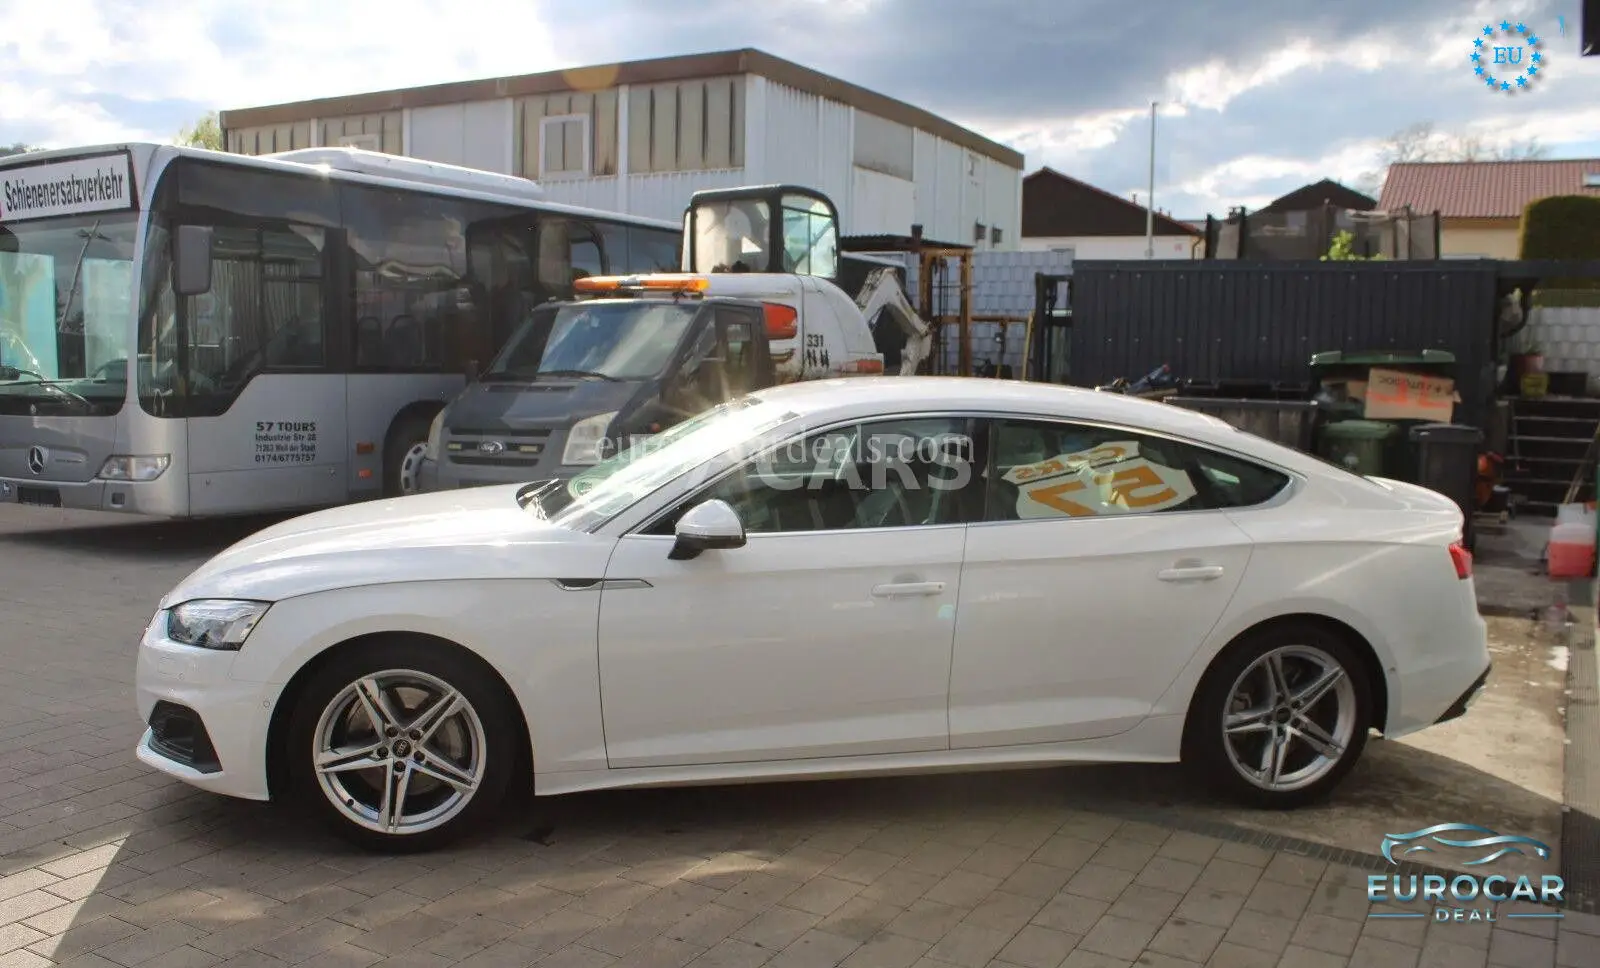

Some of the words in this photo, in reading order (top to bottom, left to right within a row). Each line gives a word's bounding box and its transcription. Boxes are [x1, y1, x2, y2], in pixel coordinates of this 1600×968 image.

[5, 167, 123, 212] Schienenersatzverkehr
[806, 334, 824, 347] 331
[256, 421, 274, 431] 57
[277, 421, 316, 432] TOURS
